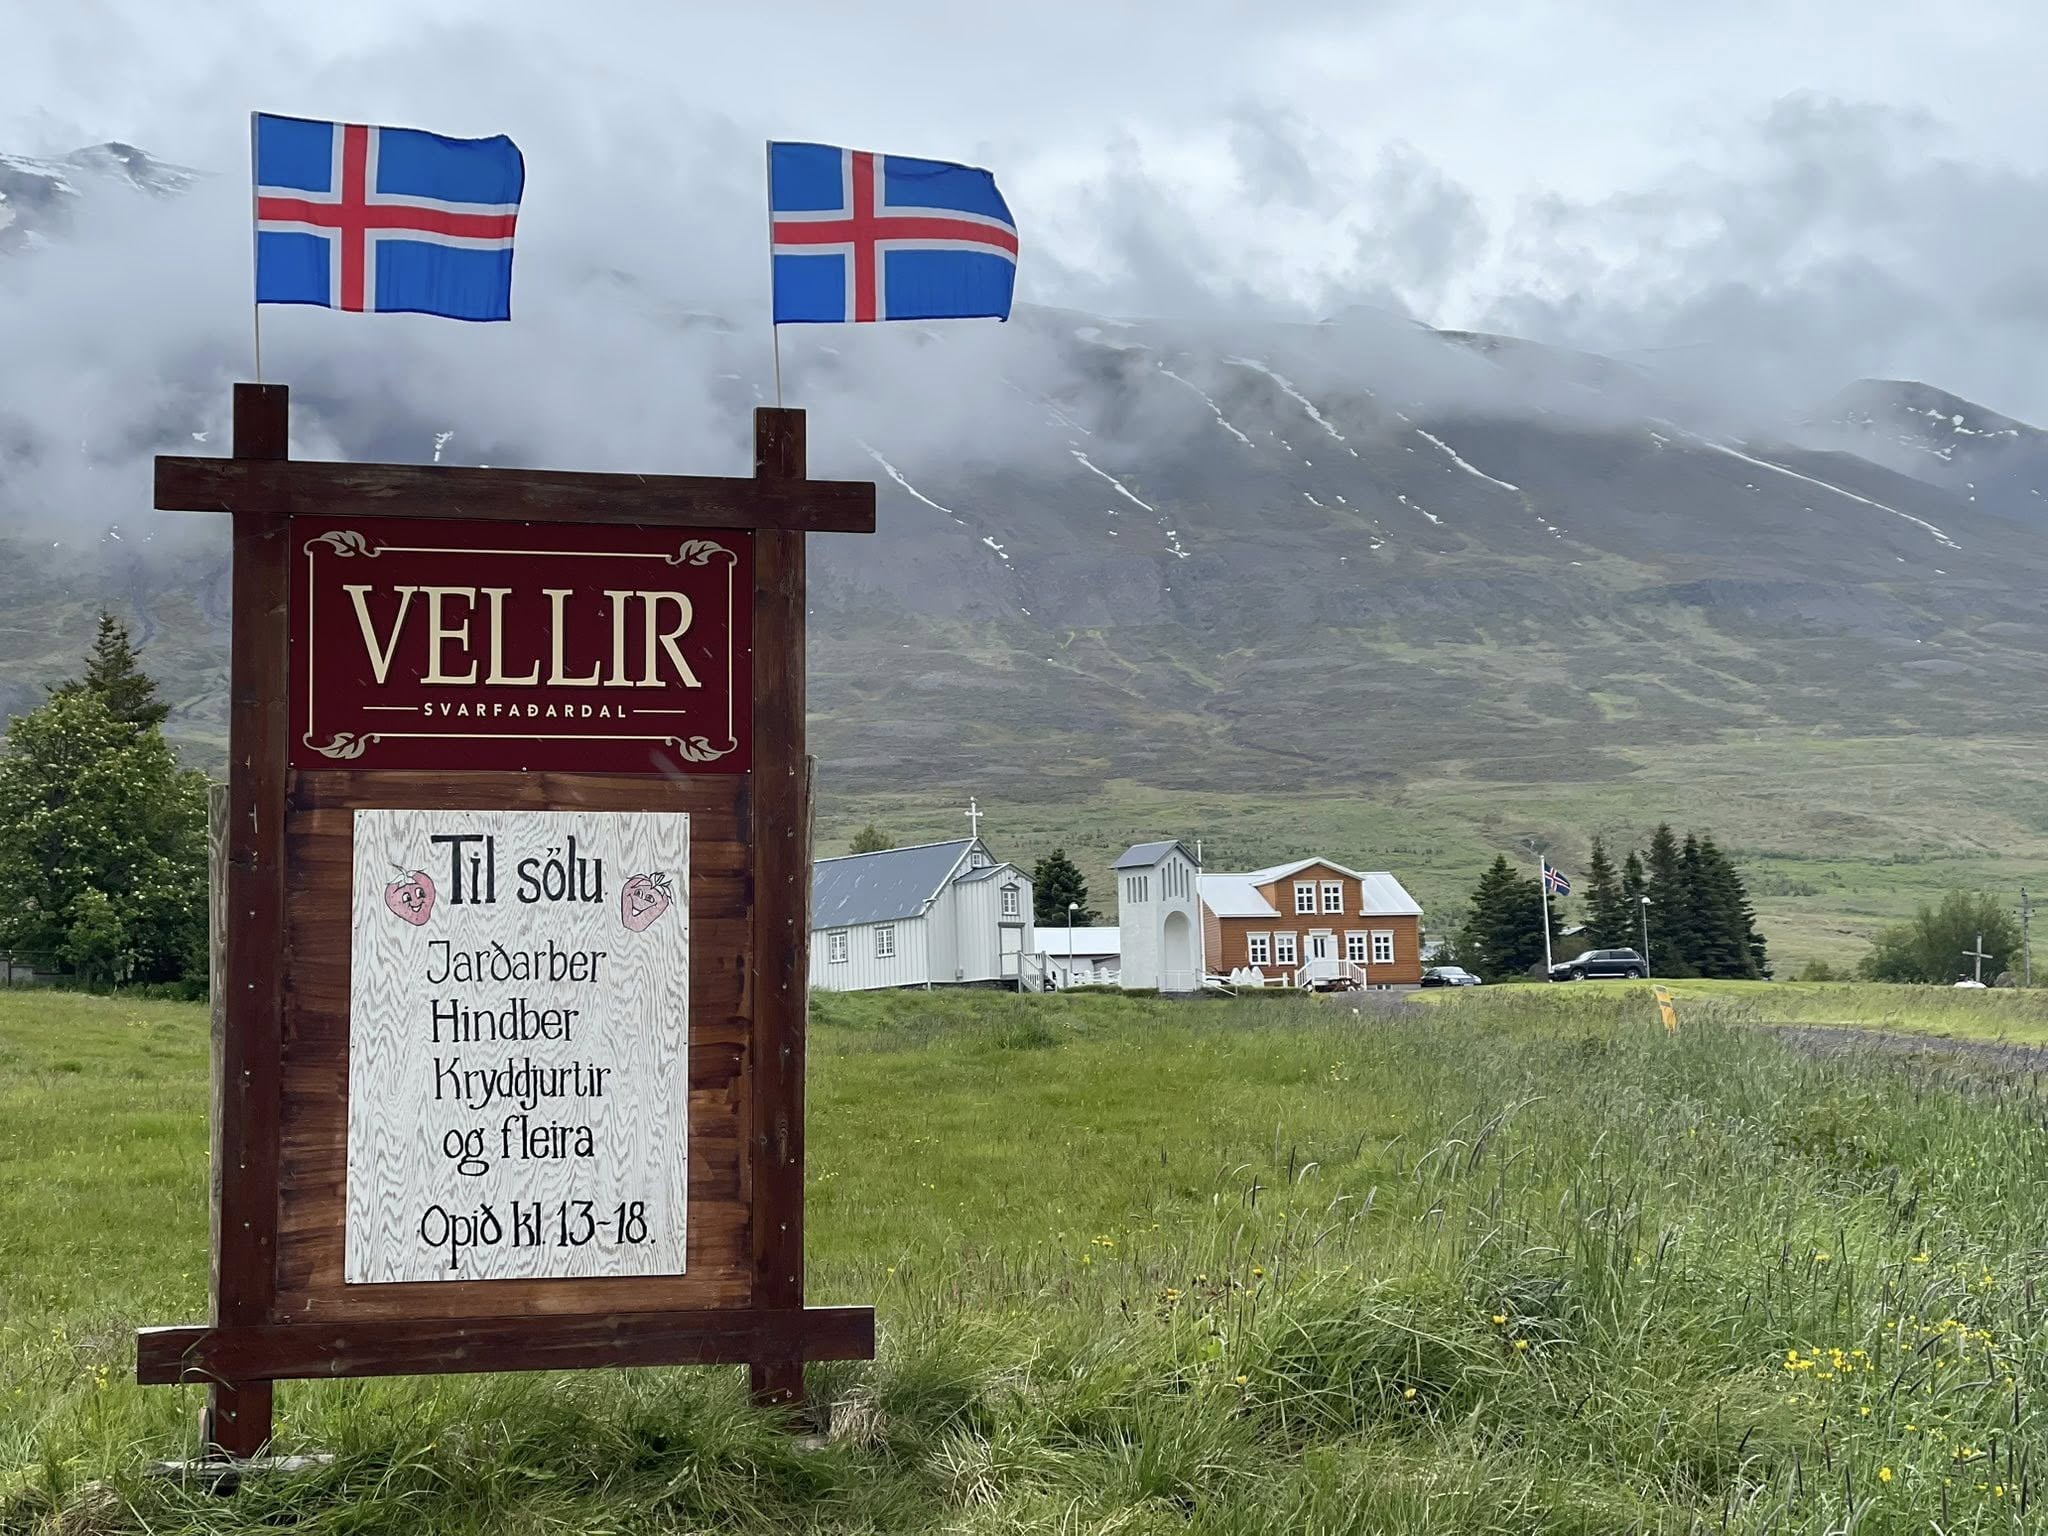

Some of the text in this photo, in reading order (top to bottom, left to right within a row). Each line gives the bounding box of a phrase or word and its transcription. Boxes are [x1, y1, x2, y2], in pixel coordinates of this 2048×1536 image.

[342, 584, 702, 688] VELLIR
[423, 702, 628, 719] SVARFAÐARDAL
[431, 834, 603, 904] Til sölu
[427, 939, 607, 984] Jarðarber
[430, 997, 579, 1043] Hindber
[433, 1057, 611, 1110] Kryddjurtir
[443, 1115, 595, 1176] og fleira
[420, 1203, 503, 1270] Opið
